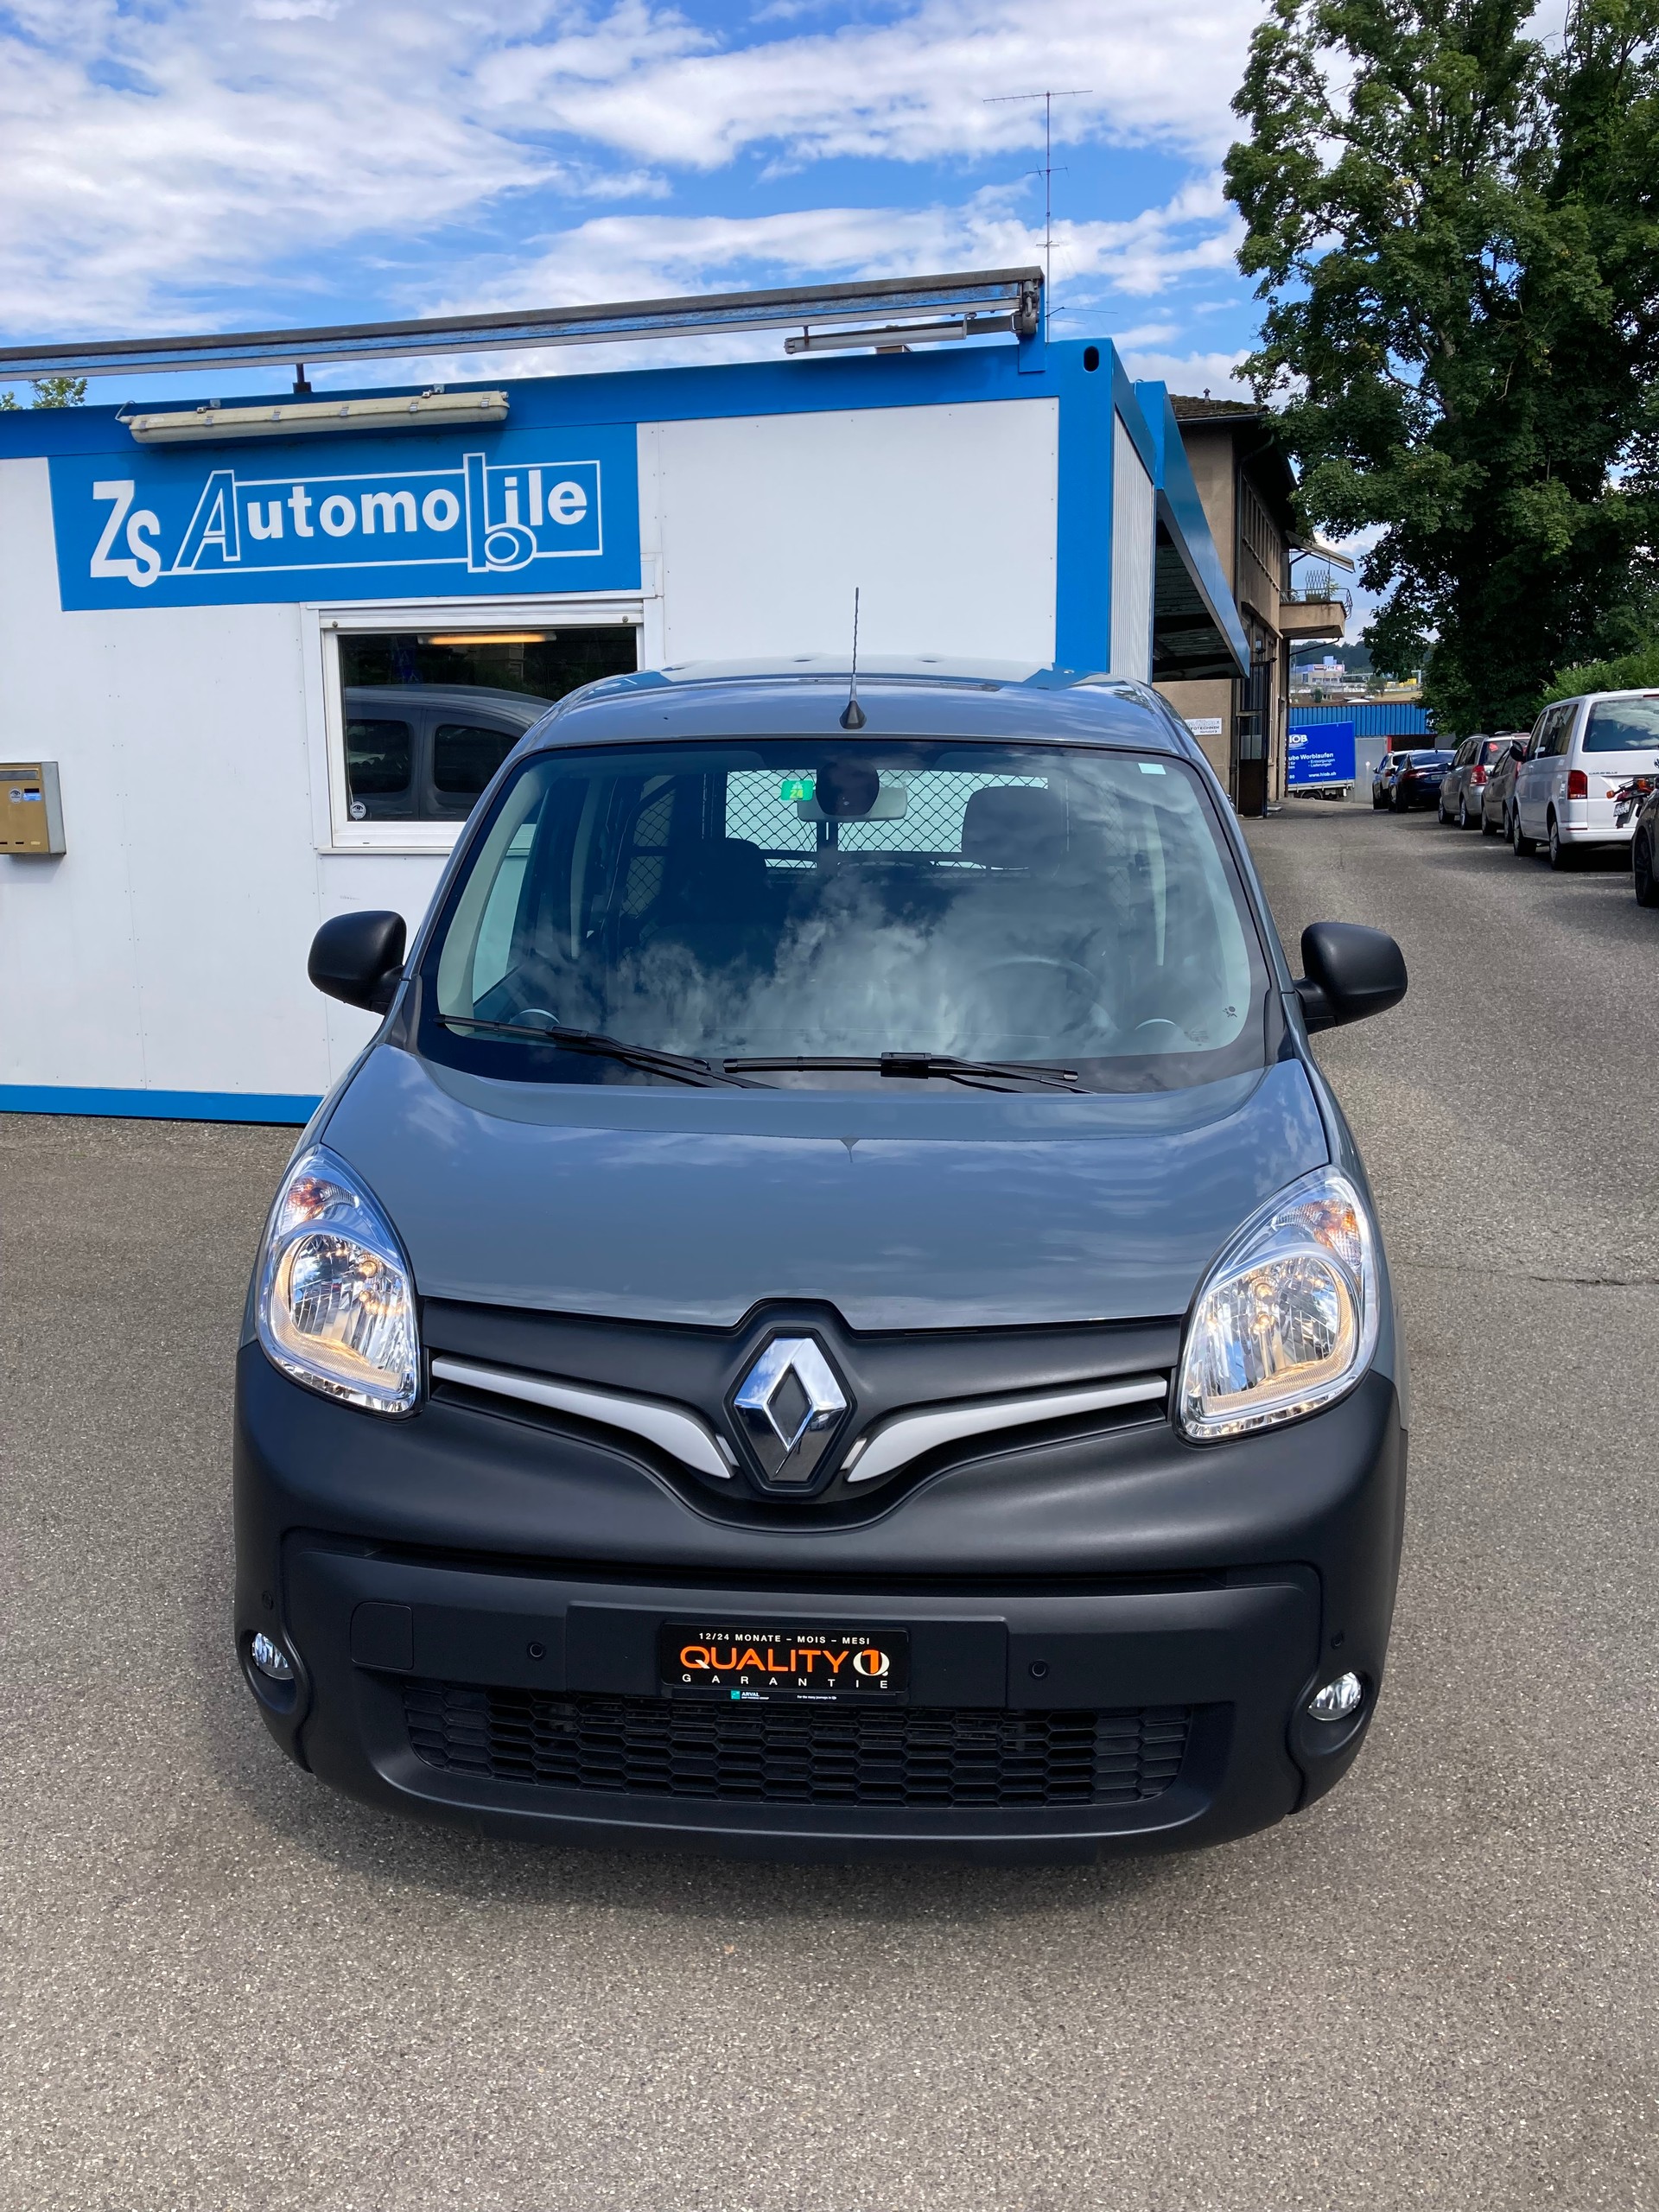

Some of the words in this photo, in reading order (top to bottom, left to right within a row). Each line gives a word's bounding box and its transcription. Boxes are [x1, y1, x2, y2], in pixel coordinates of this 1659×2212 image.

[90, 480, 162, 588] Zs
[172, 453, 588, 573] Automobile
[1289, 734, 1307, 743] IOB
[790, 789, 804, 798] 24
[698, 1632, 730, 1641] 12/24
[734, 1633, 782, 1643] MONATE
[842, 1637, 870, 1645] MESI
[680, 1645, 850, 1674] QUALITY
[682, 1674, 888, 1688] GARANTIE
